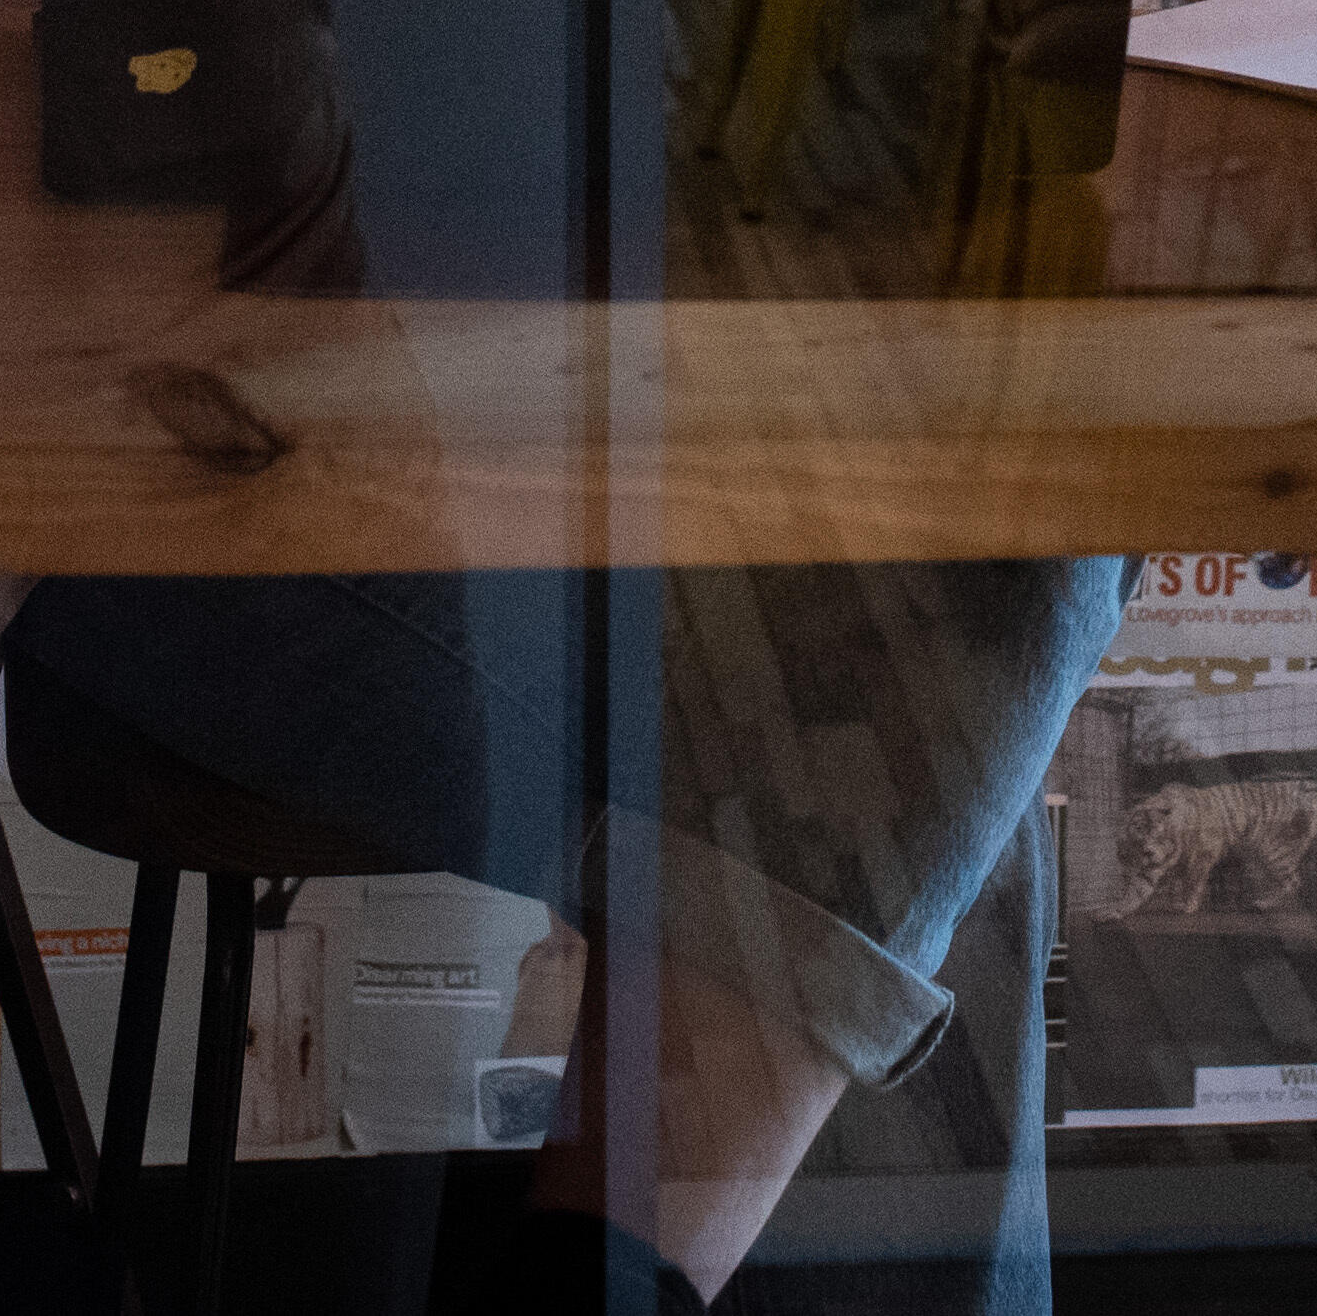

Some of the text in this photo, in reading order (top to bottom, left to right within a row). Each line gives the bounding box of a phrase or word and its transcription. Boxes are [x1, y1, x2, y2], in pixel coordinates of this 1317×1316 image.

[1195, 556, 1246, 596] OF
[1232, 607, 1312, 626] approach
[449, 966, 479, 985] art
